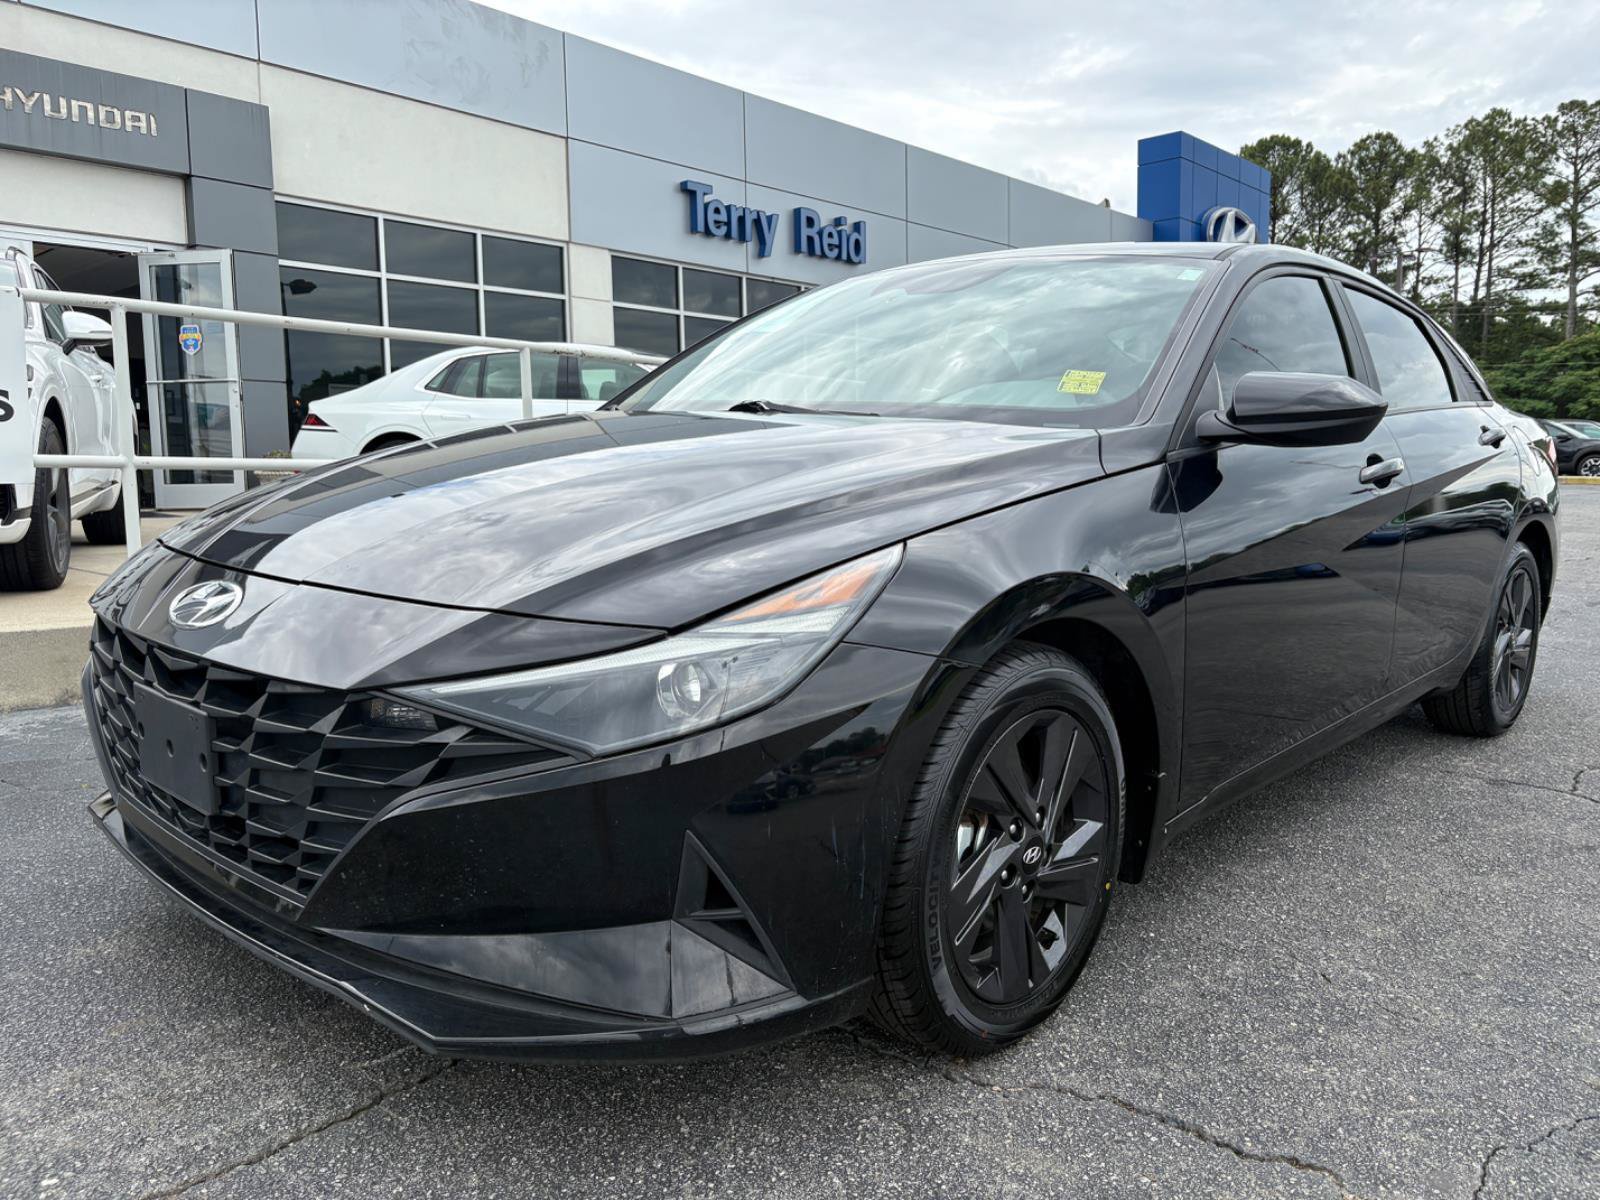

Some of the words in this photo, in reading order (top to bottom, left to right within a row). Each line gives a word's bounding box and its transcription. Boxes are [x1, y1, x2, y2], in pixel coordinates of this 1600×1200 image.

[0, 86, 158, 137] HYUNDAI
[680, 180, 779, 258] Terry
[793, 207, 866, 264] Reid
